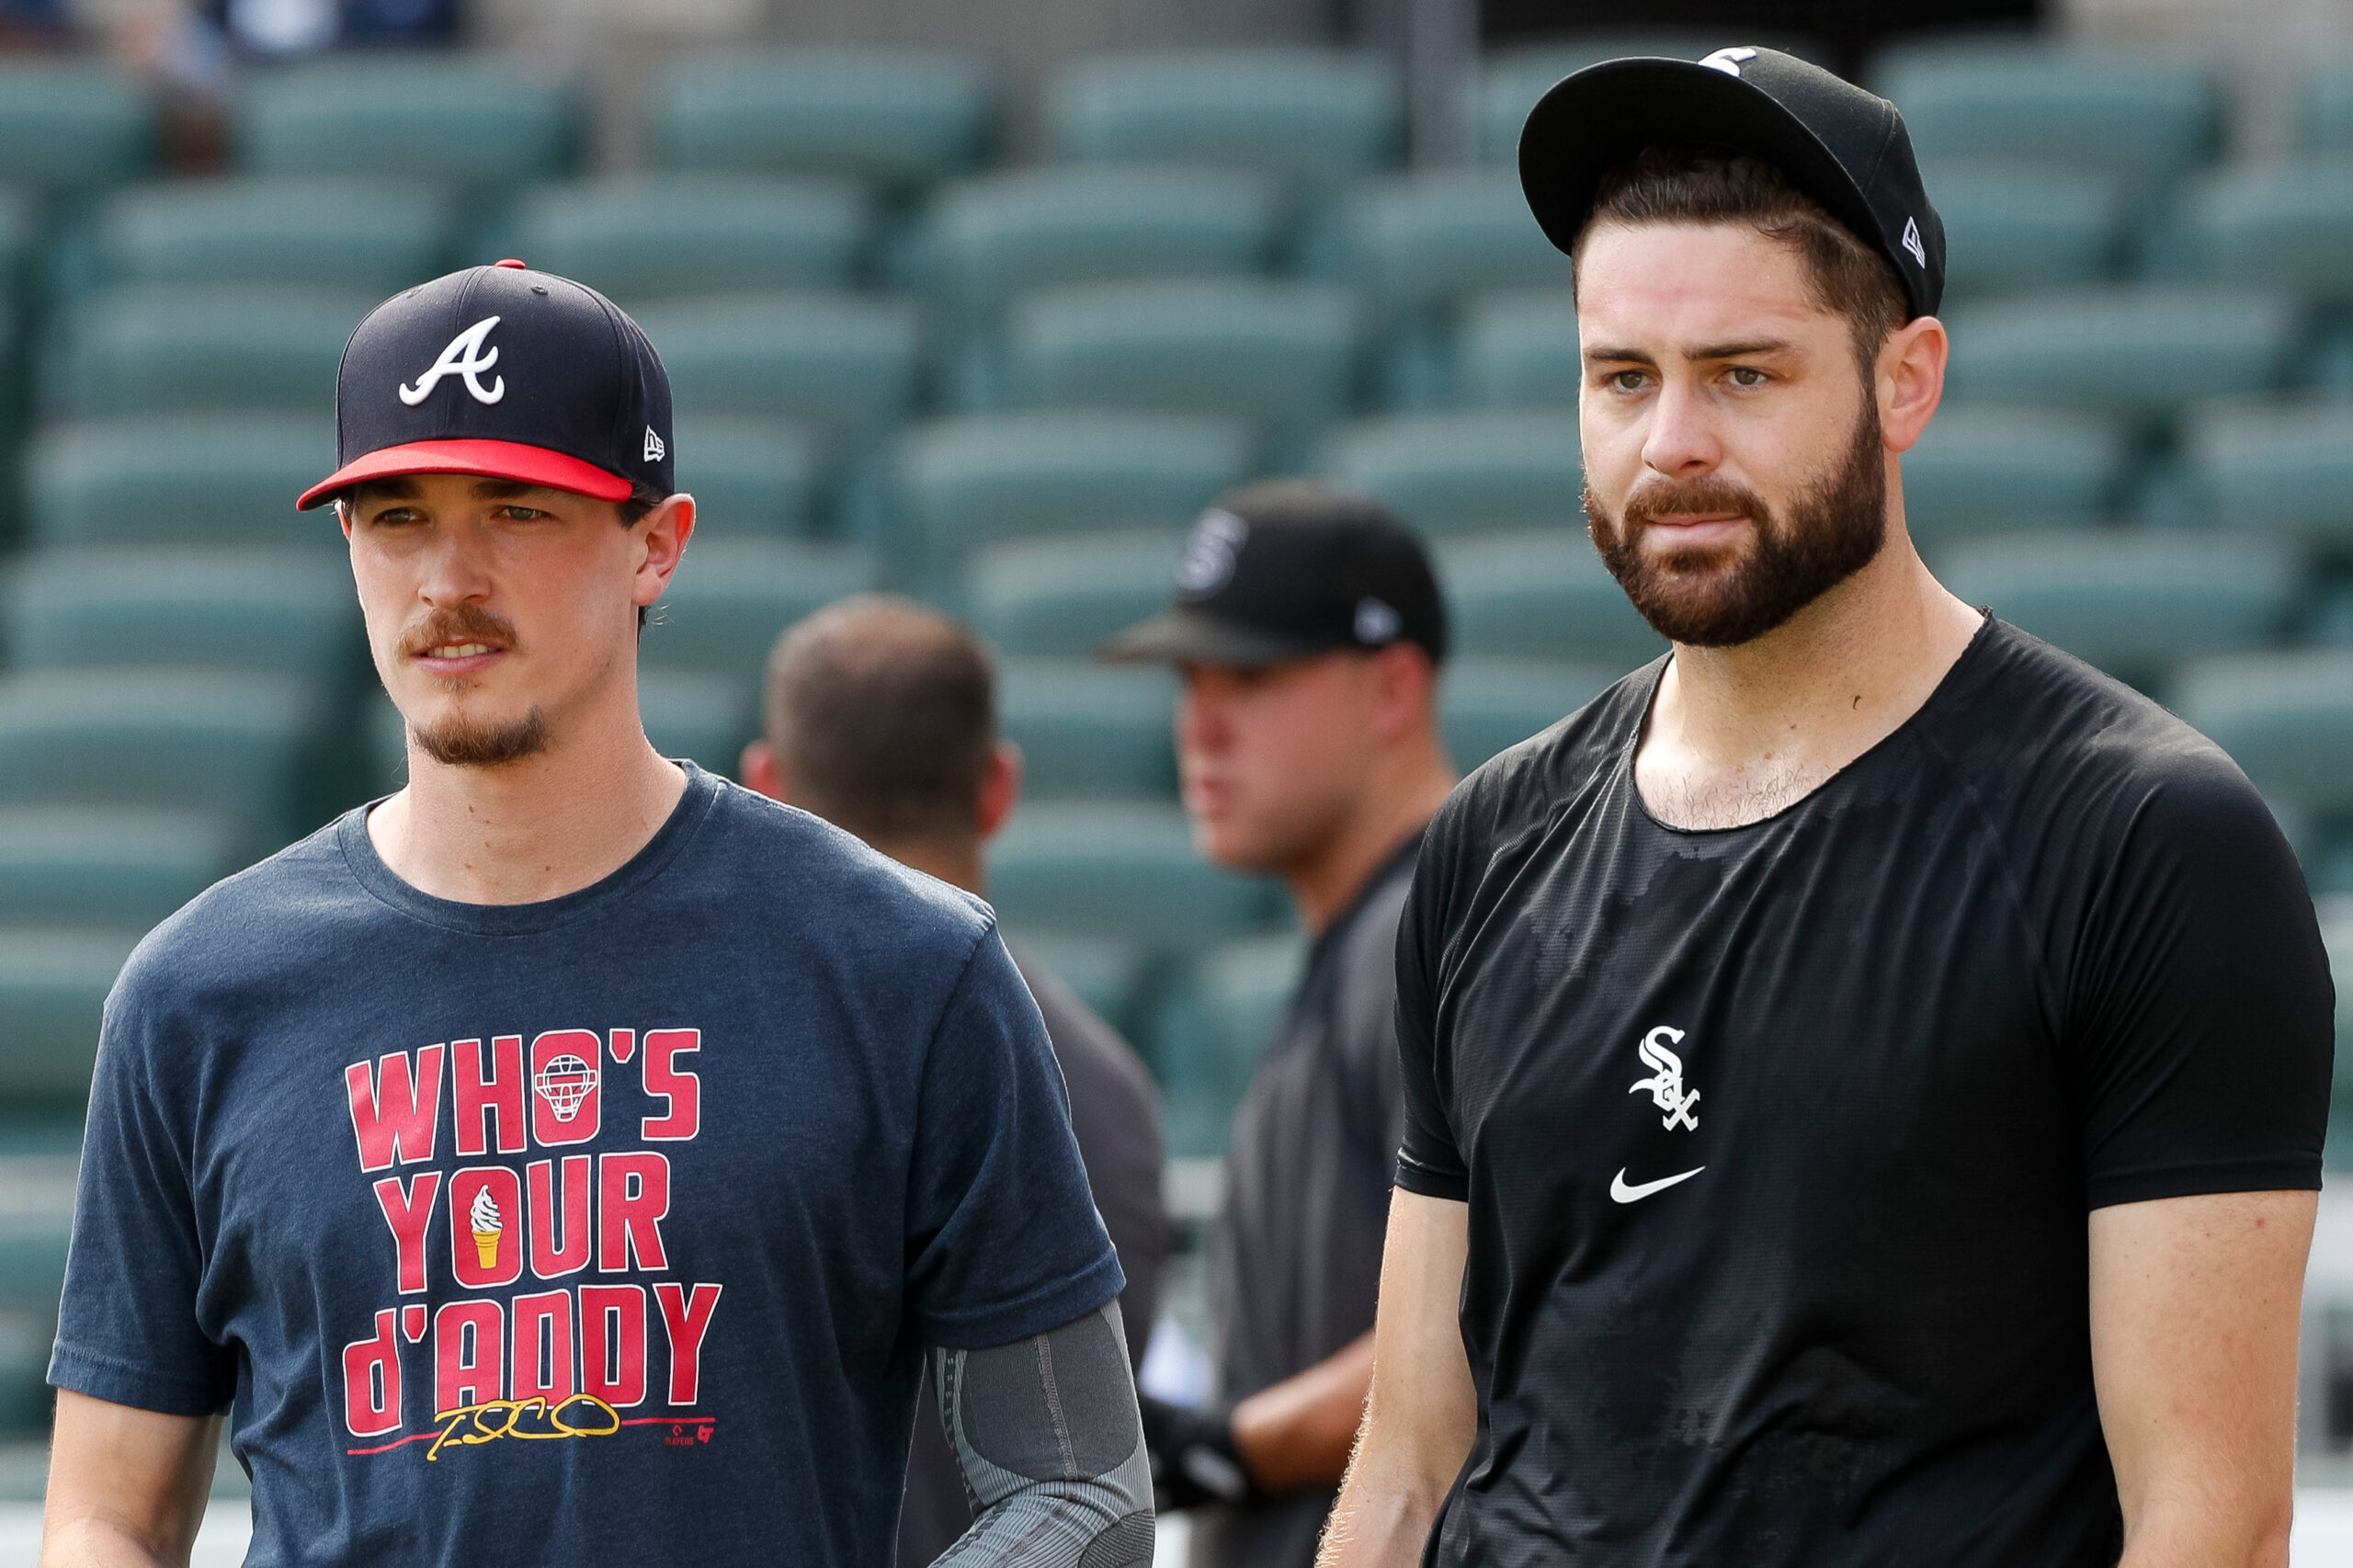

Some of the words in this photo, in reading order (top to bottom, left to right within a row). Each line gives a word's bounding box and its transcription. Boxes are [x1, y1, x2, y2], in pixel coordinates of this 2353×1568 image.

[399, 315, 505, 405] A
[344, 1028, 701, 1173] WHO'S
[372, 1151, 671, 1294] YOUR
